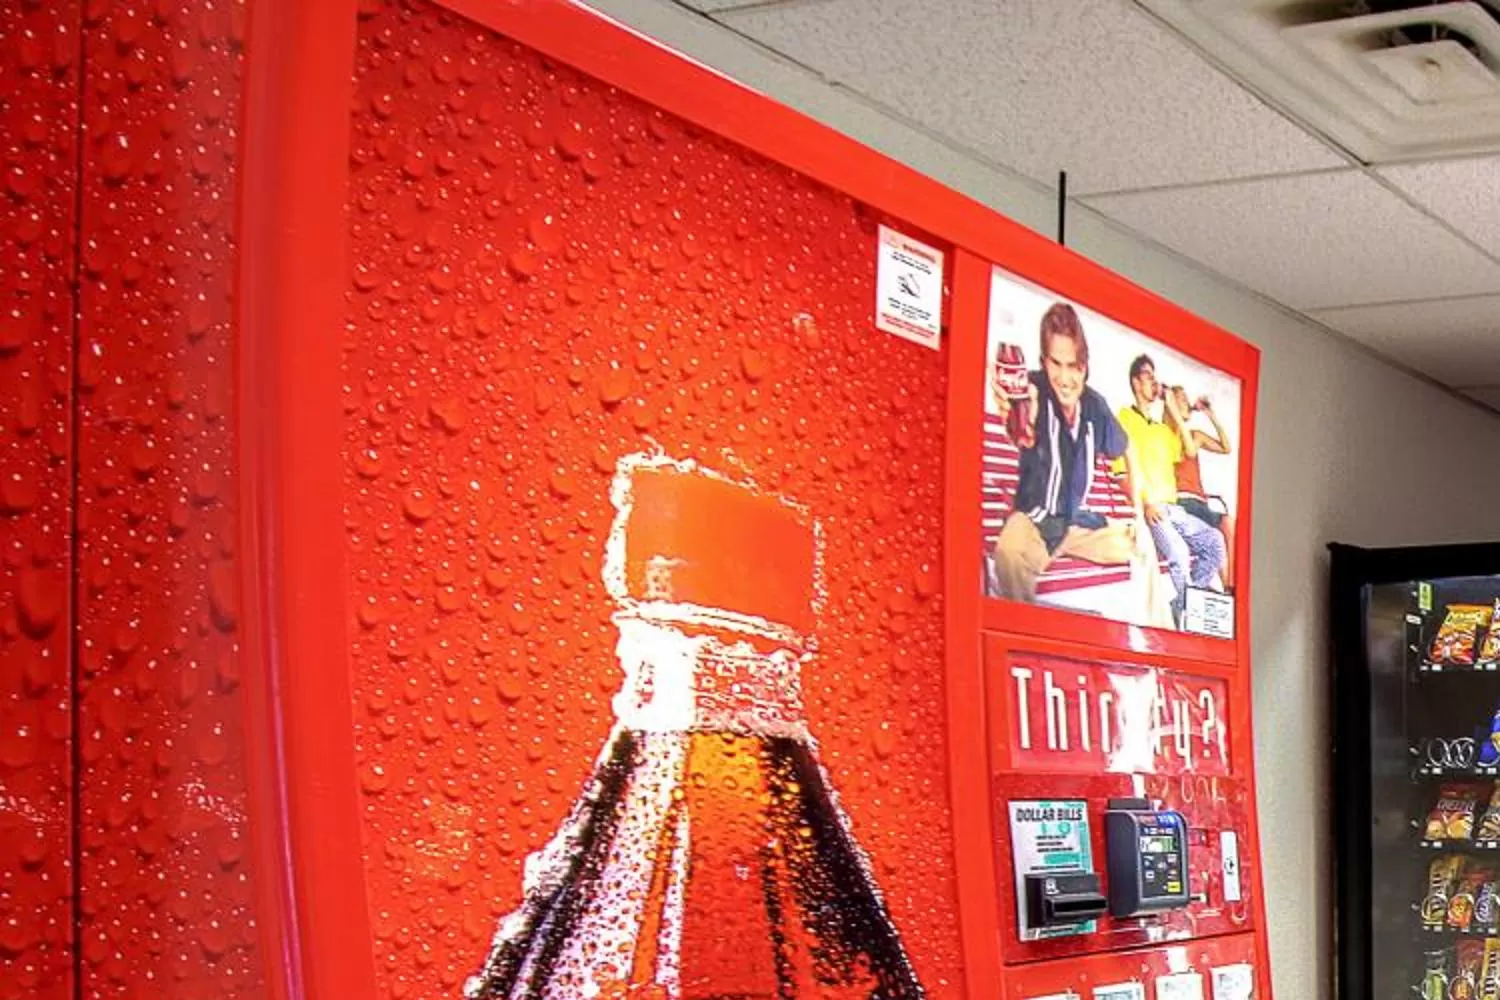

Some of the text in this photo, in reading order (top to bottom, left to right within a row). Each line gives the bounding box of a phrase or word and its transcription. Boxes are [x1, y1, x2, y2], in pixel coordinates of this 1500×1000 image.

[1011, 667, 1217, 773] Thirty?
[1016, 807, 1083, 822] DOLLAR BILLS
